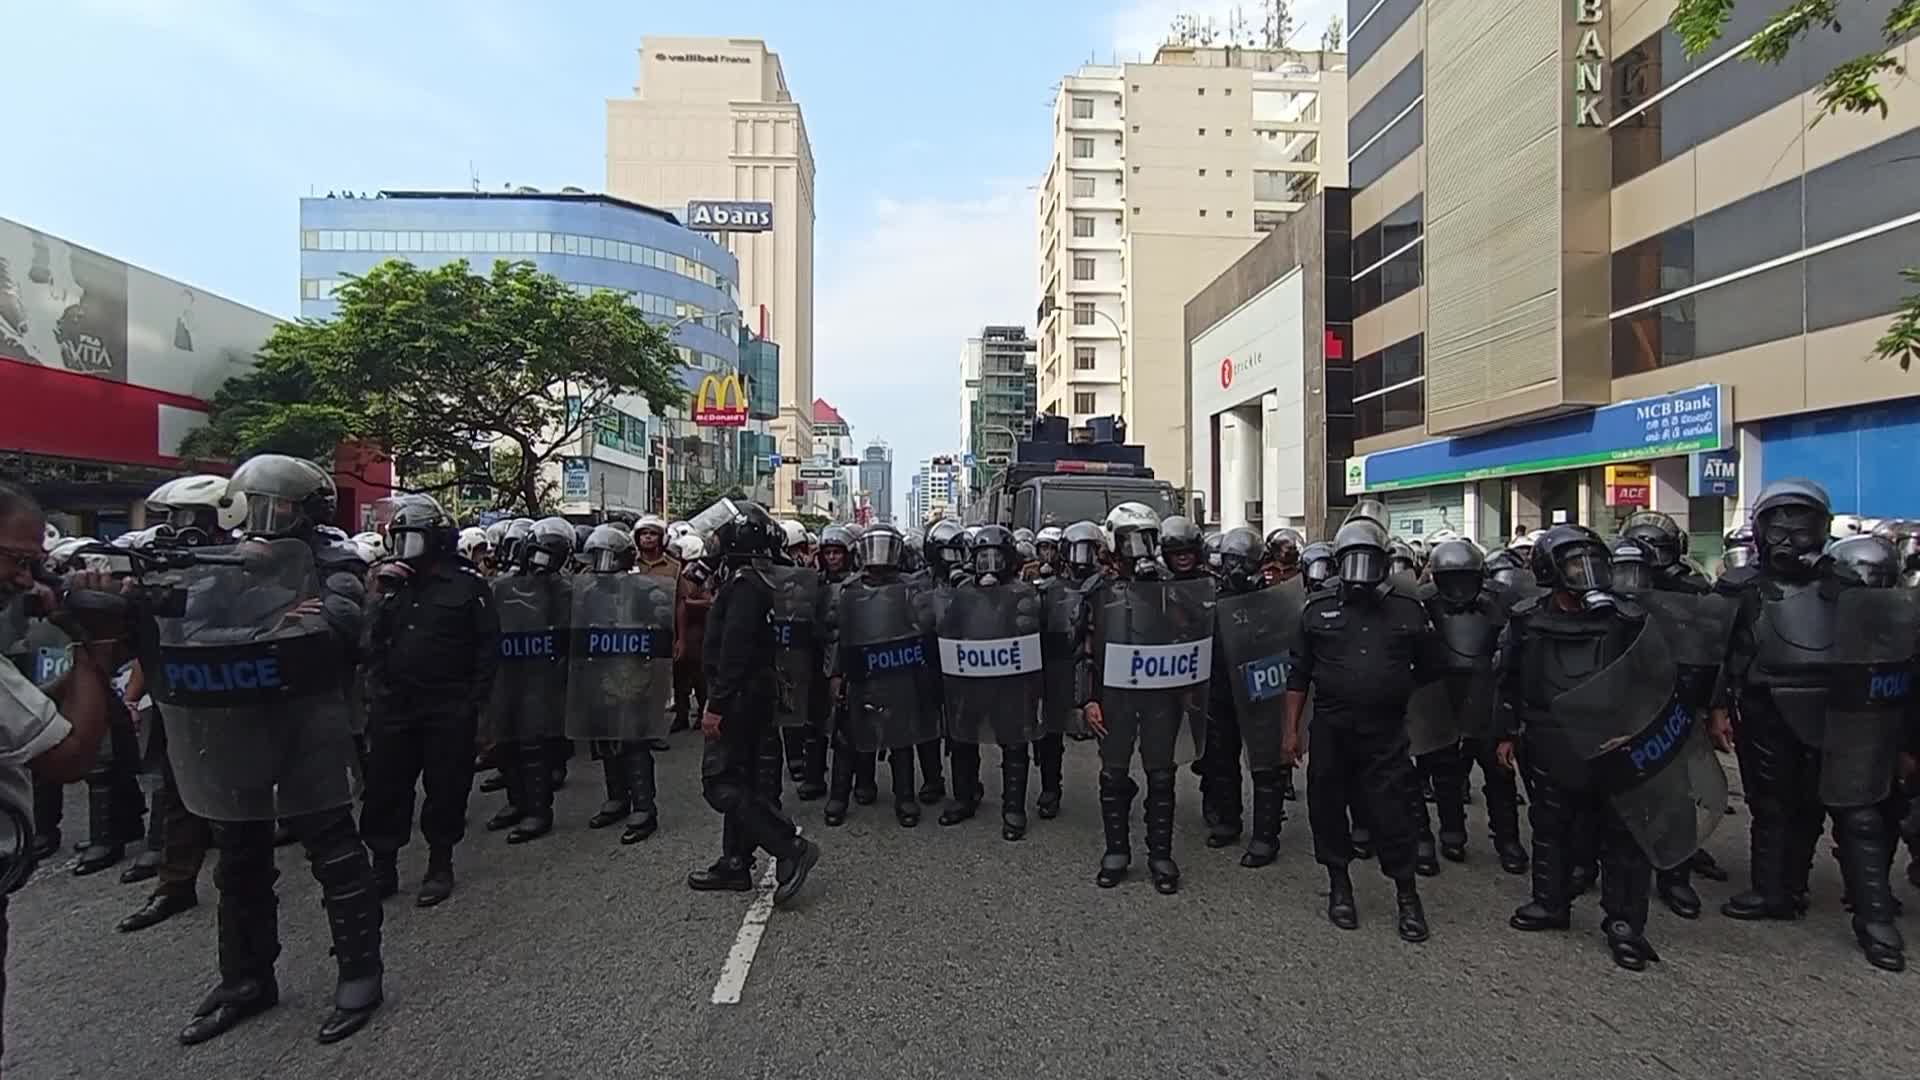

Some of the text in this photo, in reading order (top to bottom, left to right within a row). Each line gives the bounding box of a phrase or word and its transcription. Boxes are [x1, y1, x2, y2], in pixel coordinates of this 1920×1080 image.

[1576, 0, 1605, 126] BANK
[693, 205, 769, 225] Abans
[1636, 395, 1712, 421] MCB Bank
[1703, 462, 1735, 477] ATM
[1619, 487, 1647, 498] ACE
[502, 635, 553, 656] OLICE
[589, 633, 650, 653] POLICE
[867, 645, 923, 670] POLICE
[957, 647, 1021, 667] POLICE
[1131, 654, 1198, 677] POLICE
[166, 659, 280, 691] POLICE
[1630, 703, 1688, 769] POLICE
